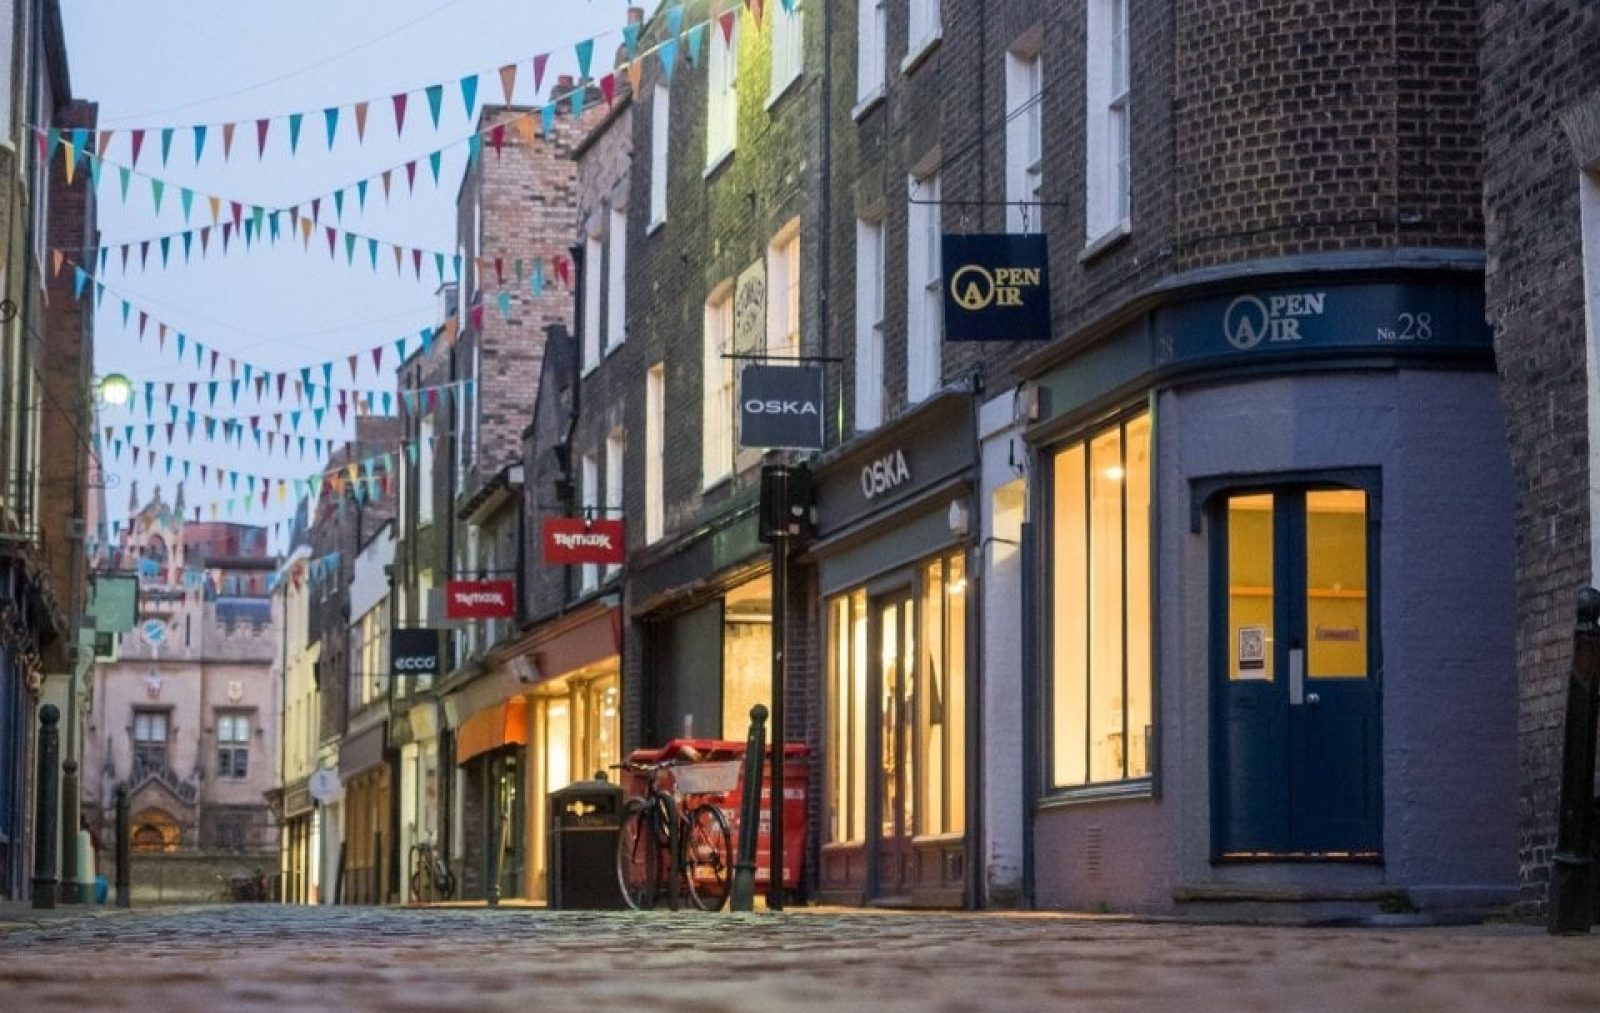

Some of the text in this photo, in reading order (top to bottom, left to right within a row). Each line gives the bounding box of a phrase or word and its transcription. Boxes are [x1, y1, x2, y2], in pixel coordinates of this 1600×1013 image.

[744, 399, 818, 415] OSKA
[861, 449, 911, 499] OSKA
[394, 656, 436, 670] ecco
